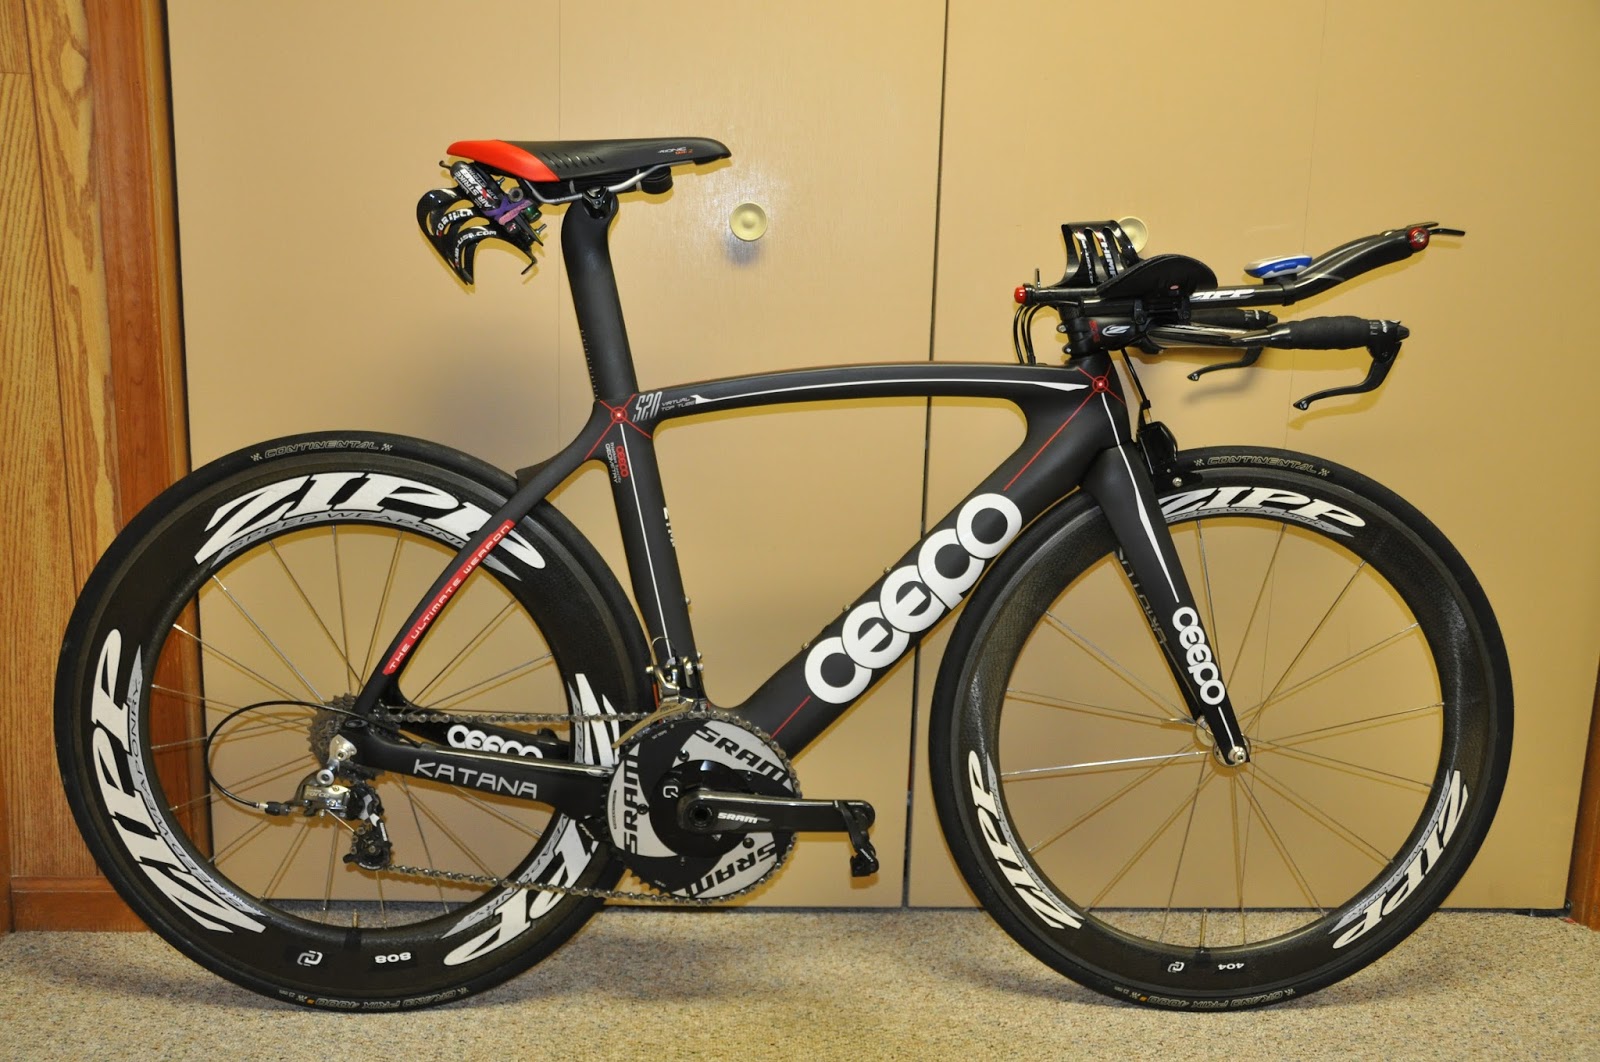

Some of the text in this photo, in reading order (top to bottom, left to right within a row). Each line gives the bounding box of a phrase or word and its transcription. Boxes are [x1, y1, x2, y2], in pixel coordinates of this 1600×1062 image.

[454, 170, 479, 196] STRIKE
[265, 440, 379, 460] CONTINENTAL
[1207, 455, 1318, 474] CONTINENTAL
[194, 471, 546, 569] ZIPP
[1158, 486, 1366, 527] ZIPP
[389, 525, 510, 669] THE ULTIMATE WEAPON
[695, 726, 786, 782] SRAM
[92, 629, 267, 934] ZIPP
[413, 759, 538, 799] KATANA
[624, 755, 639, 858] SRAM
[718, 811, 758, 824] SRAM
[968, 750, 1082, 930] ZIPP
[686, 841, 778, 898] SRAM
[1333, 770, 1469, 949] ZIPP
[375, 951, 412, 964] 808
[1218, 962, 1245, 971] 404
[315, 997, 360, 1009] 4000
[362, 1000, 400, 1009] PRIX
[1147, 995, 1190, 1008] 4000
[1191, 1000, 1229, 1009] PRIX
